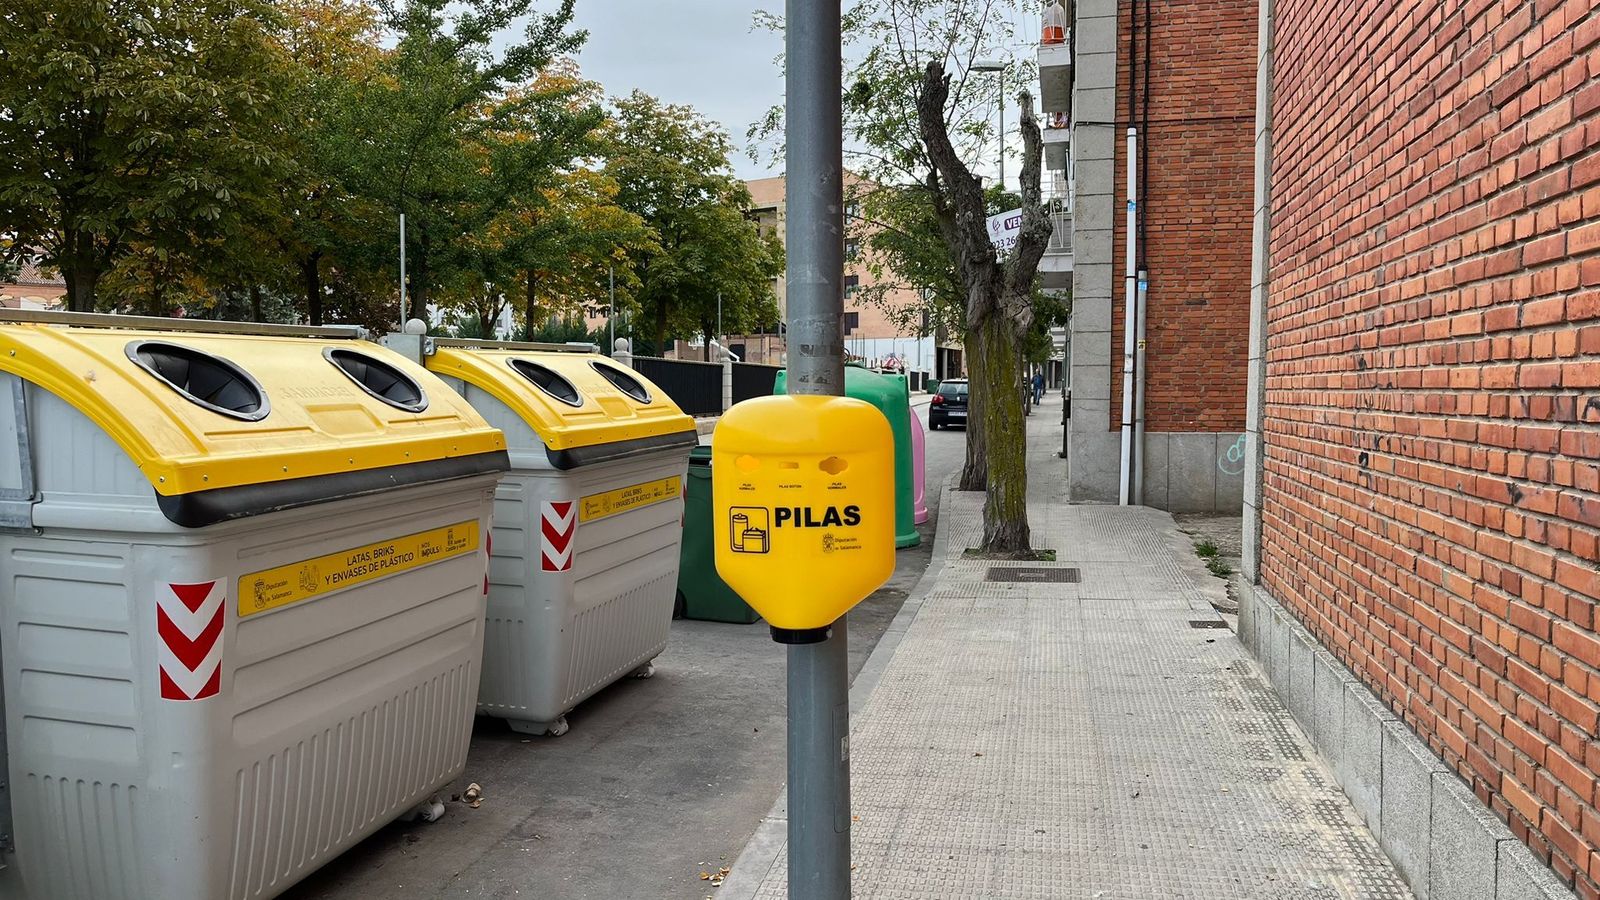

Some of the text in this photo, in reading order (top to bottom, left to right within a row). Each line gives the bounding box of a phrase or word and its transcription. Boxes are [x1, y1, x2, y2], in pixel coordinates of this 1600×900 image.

[774, 505, 861, 528] PILAS
[346, 545, 395, 566] LATAS, BRIKS
[325, 552, 414, 585] Y ENVASES DE PLÁSTICO
